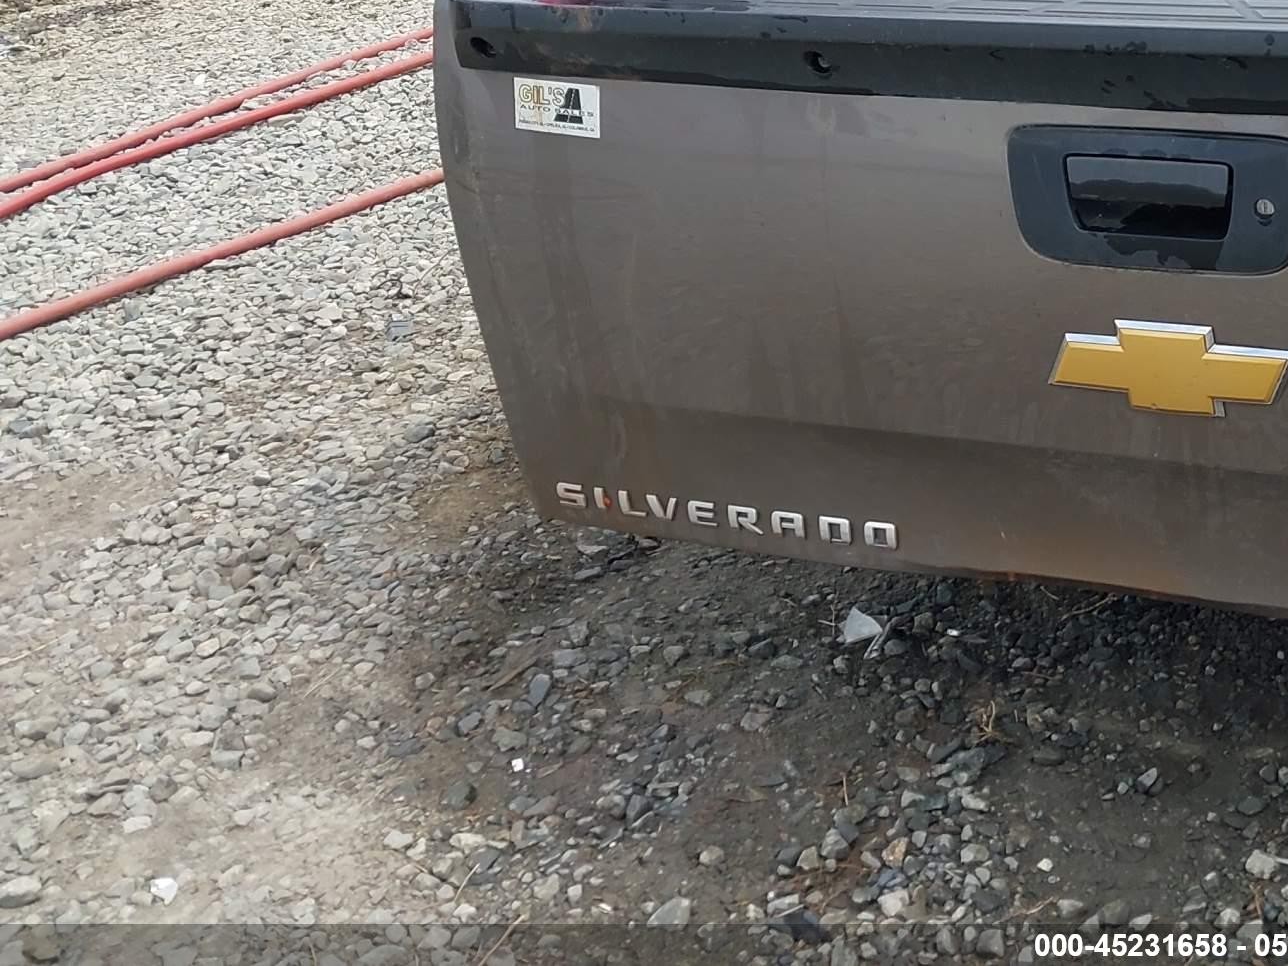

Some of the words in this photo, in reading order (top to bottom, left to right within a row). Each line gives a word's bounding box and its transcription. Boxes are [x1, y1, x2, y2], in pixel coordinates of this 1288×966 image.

[519, 84, 566, 107] GIL'S
[520, 104, 551, 113] AUTO
[556, 481, 898, 551] SILVERADO
